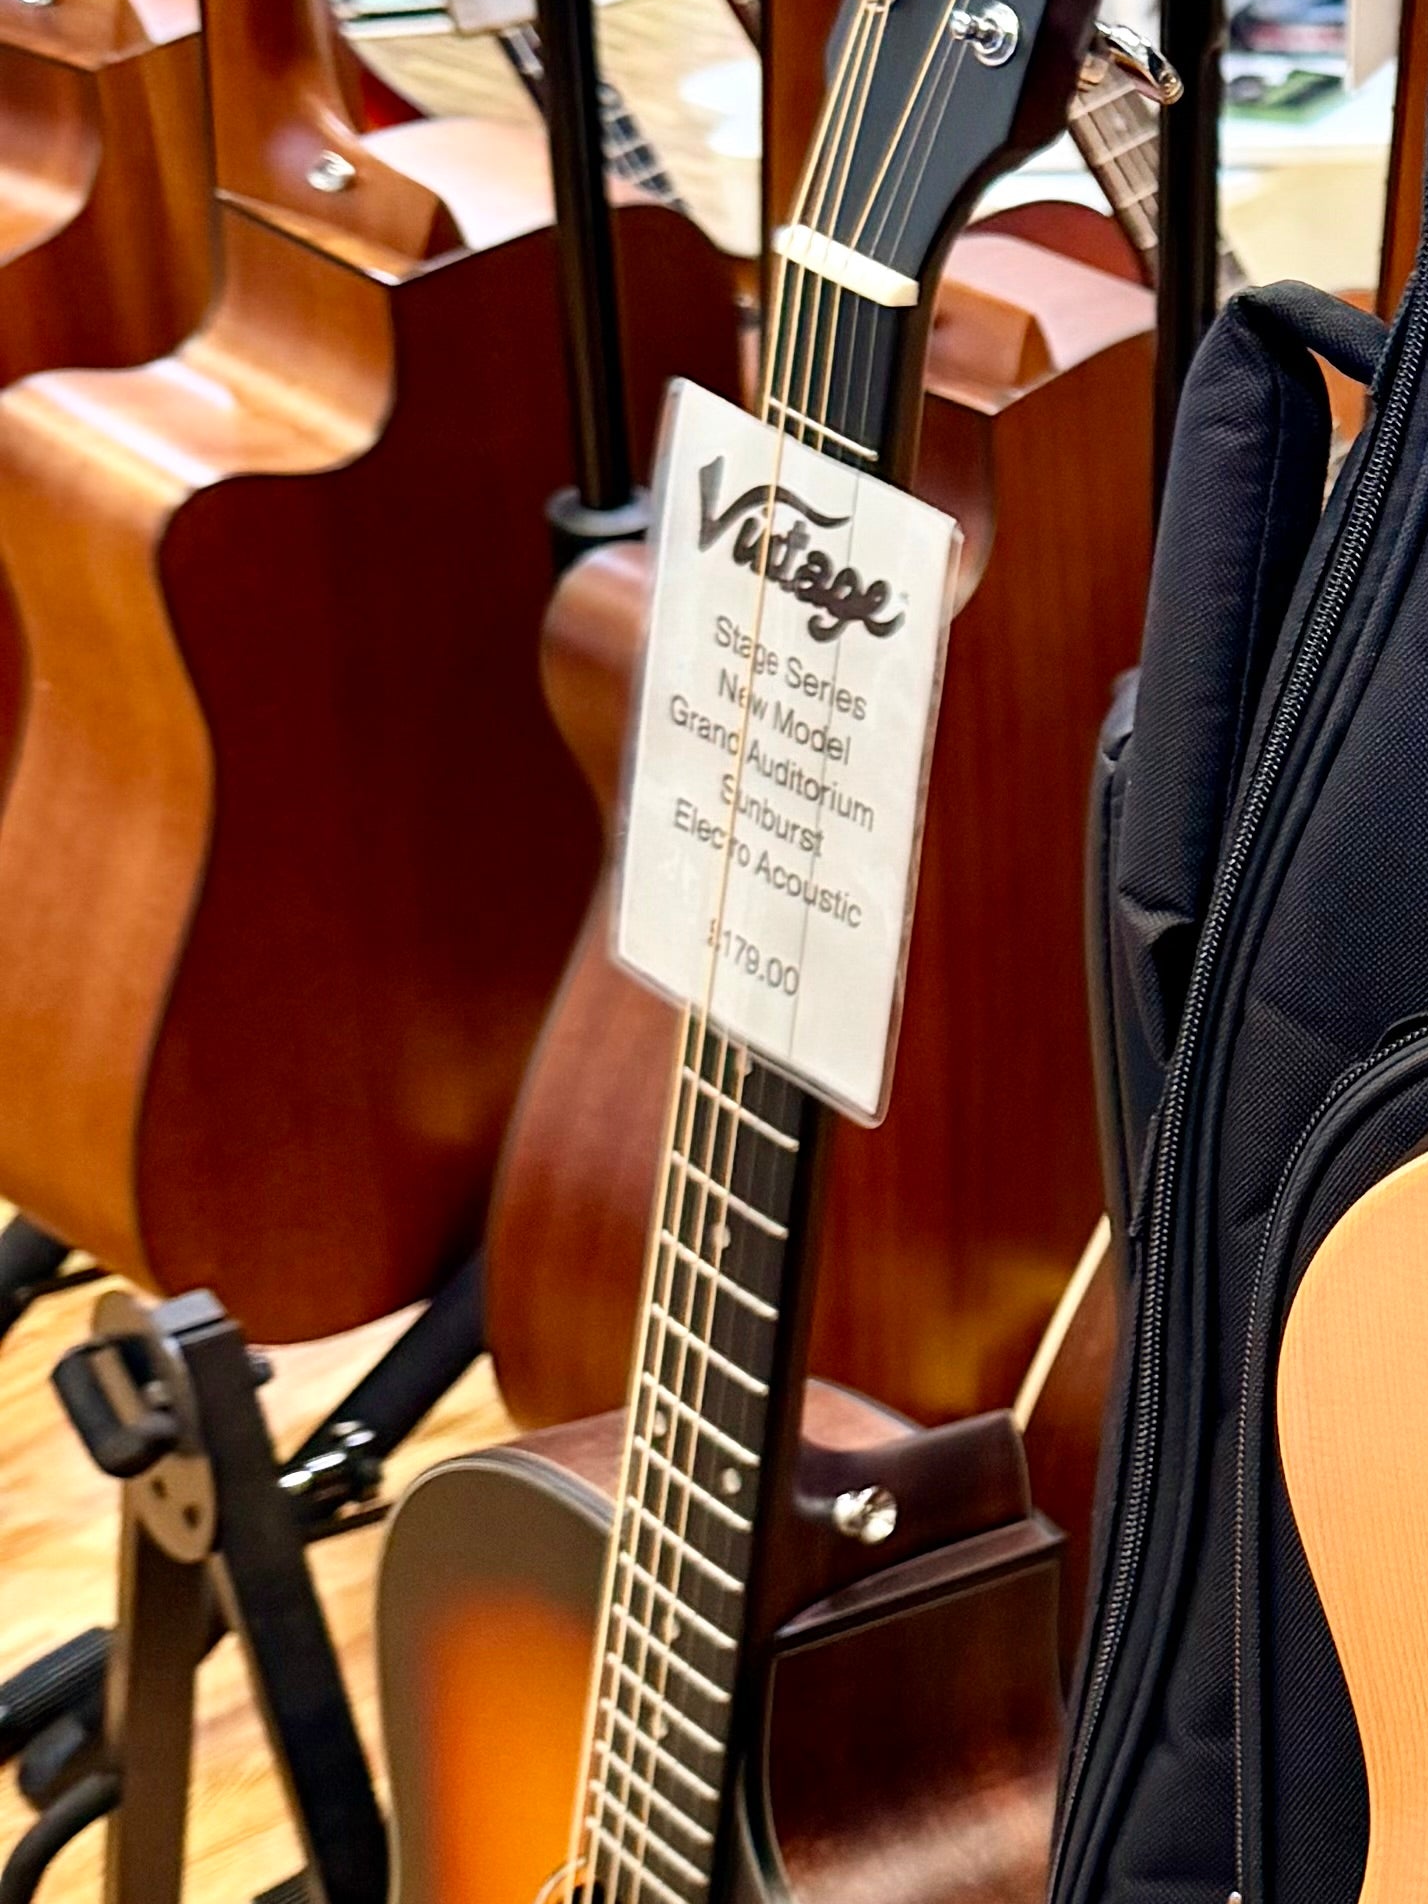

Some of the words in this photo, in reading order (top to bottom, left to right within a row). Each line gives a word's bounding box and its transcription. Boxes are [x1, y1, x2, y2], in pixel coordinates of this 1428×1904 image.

[698, 455, 906, 644] Vintage
[714, 615, 780, 675] Stage
[785, 656, 868, 721] Series
[718, 667, 769, 720] New
[772, 700, 852, 765] Model
[721, 773, 825, 858] Sunburst
[746, 739, 875, 832] Auditorium
[673, 797, 751, 868] Elecro
[754, 850, 863, 928] Acoustic
